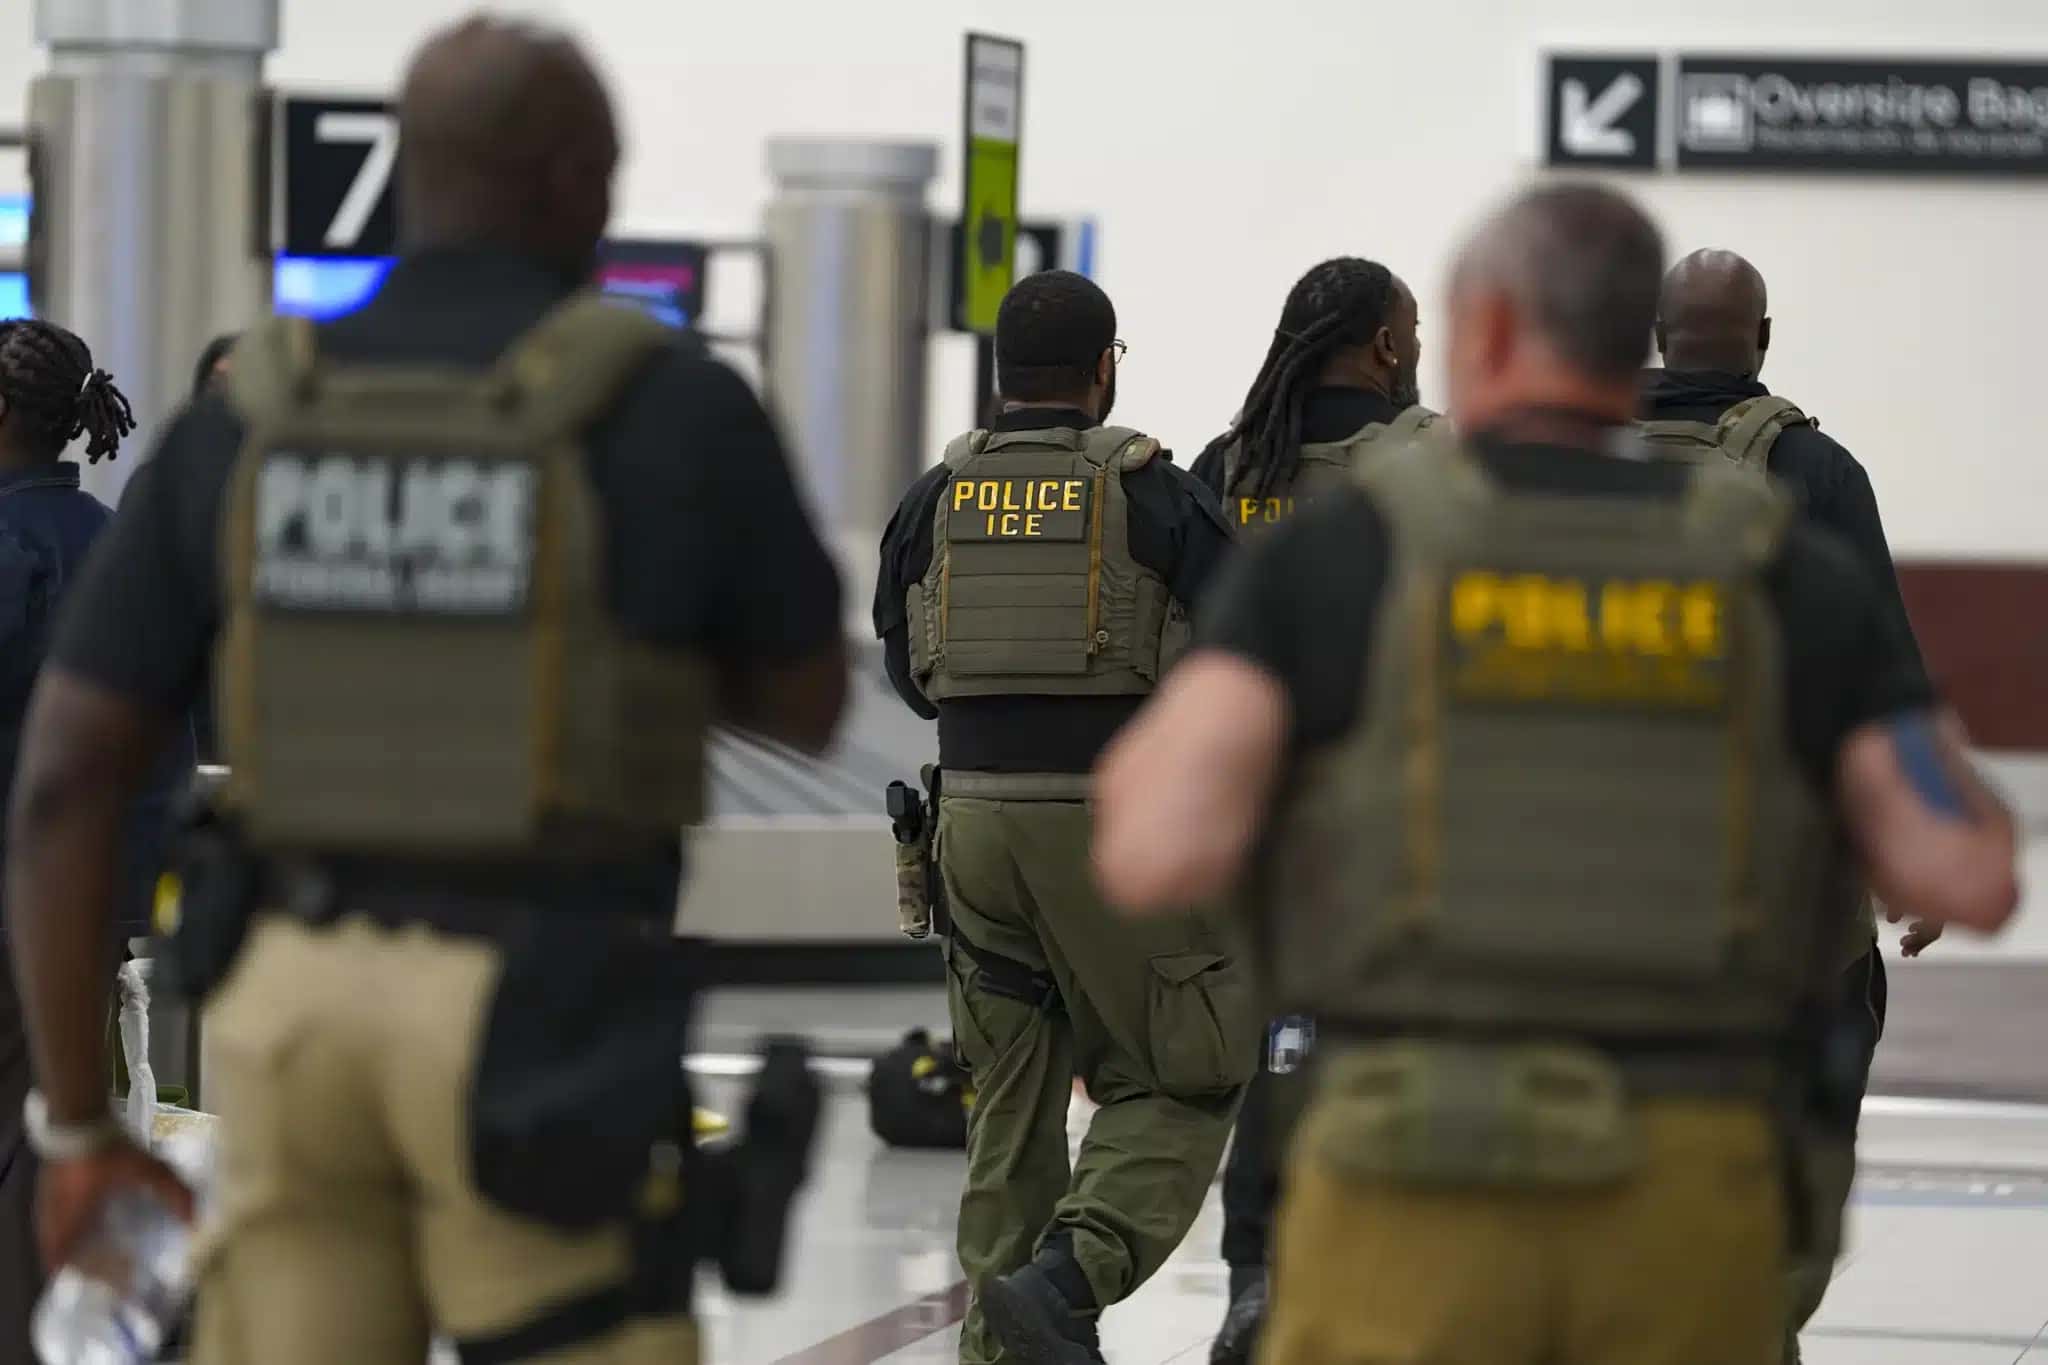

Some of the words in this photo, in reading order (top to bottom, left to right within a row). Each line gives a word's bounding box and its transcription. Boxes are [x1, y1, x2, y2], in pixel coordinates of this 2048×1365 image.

[1753, 72, 1960, 128] Oversize
[315, 112, 399, 248] 7
[257, 457, 531, 563] POLICE
[953, 480, 1083, 511] POLICE
[986, 513, 1043, 536] ICE
[1453, 570, 1722, 658] POLICE
